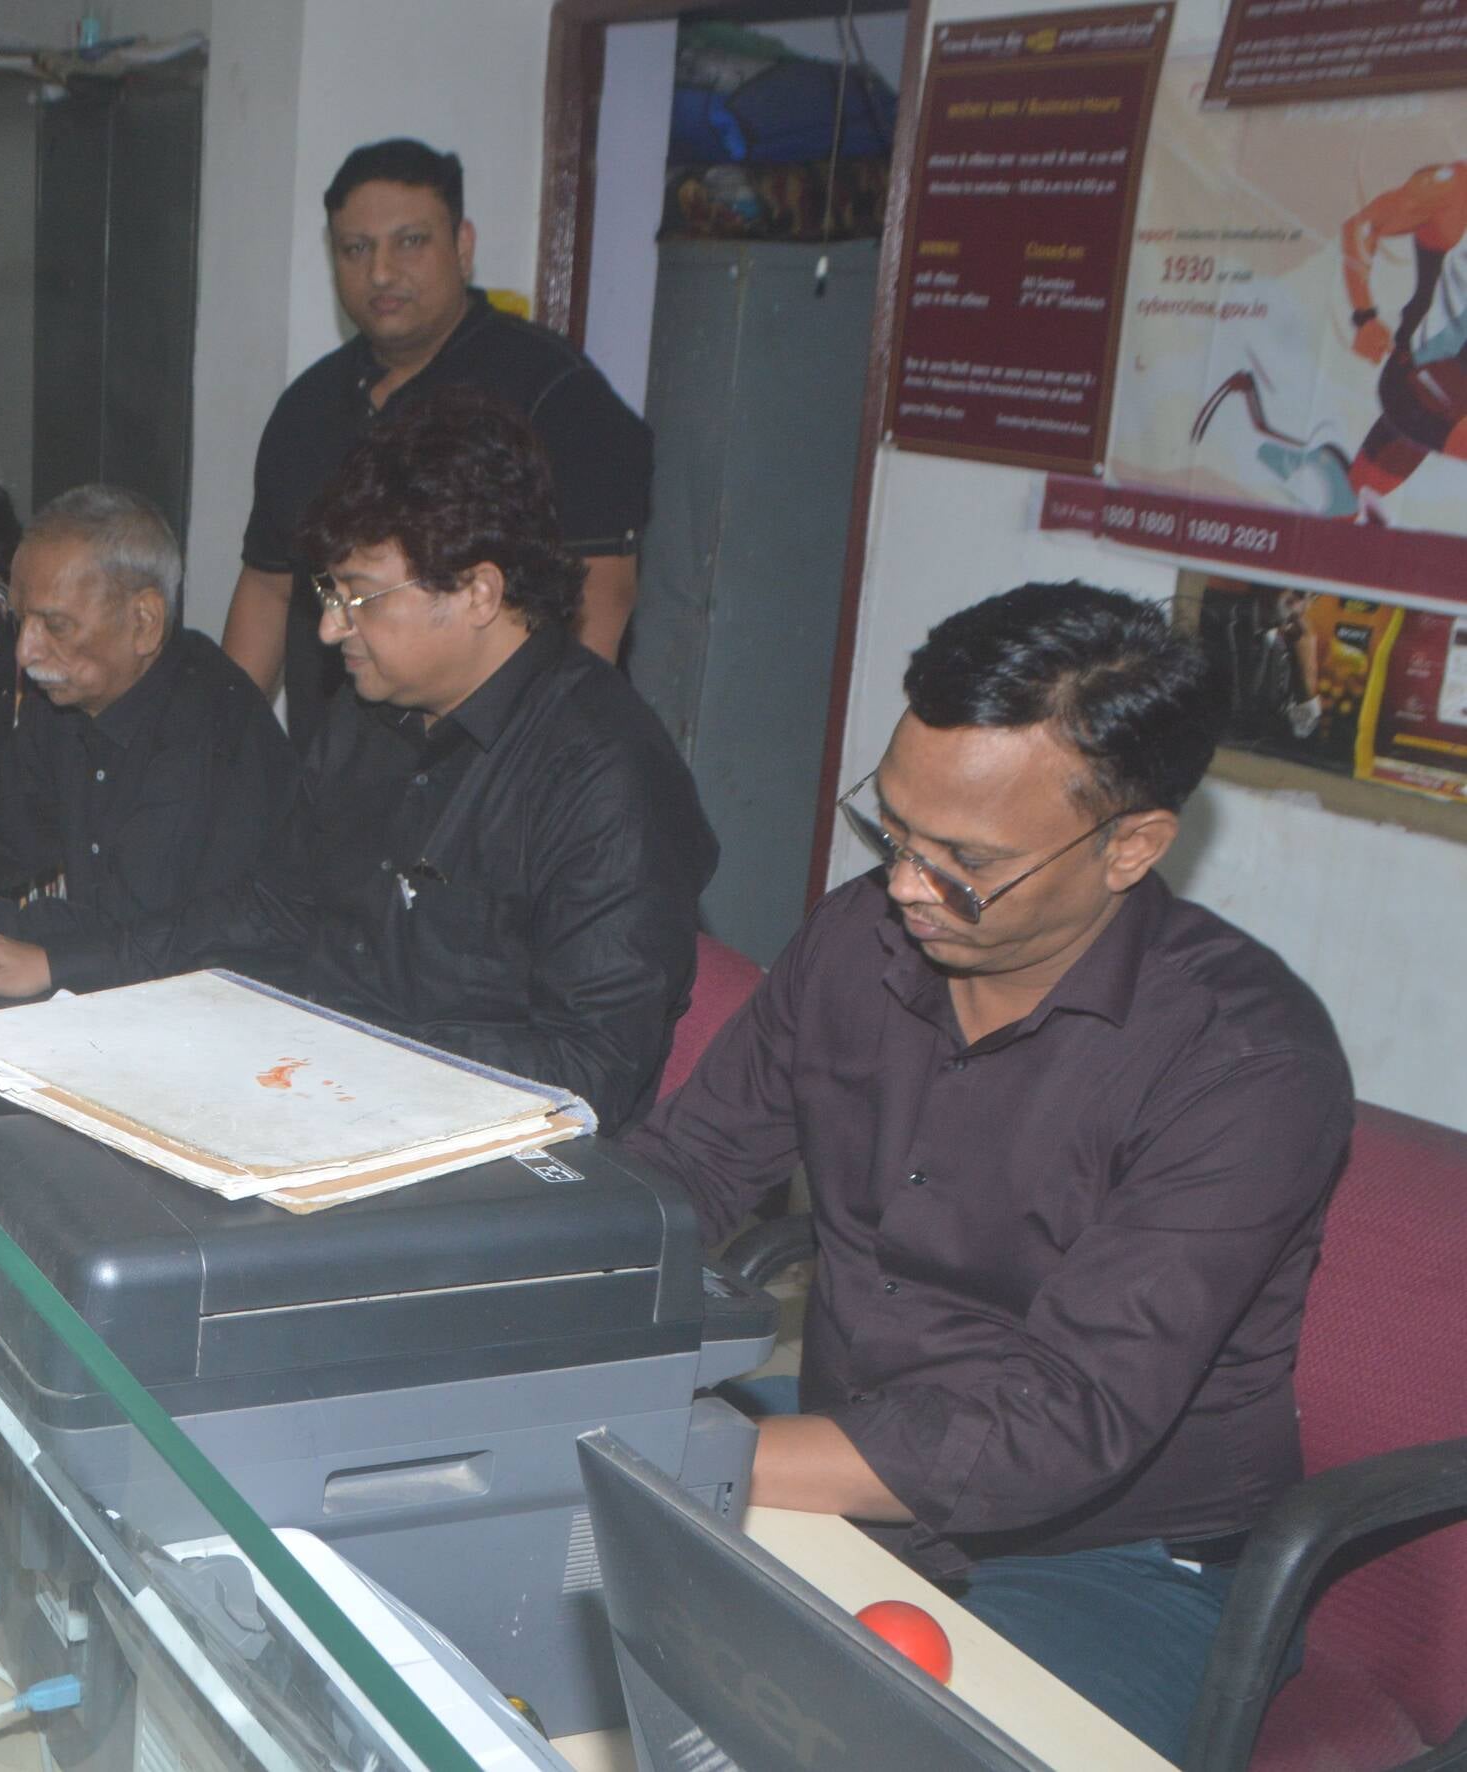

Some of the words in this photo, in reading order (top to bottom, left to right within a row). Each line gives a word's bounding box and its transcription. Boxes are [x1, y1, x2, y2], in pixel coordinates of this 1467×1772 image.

[1161, 255, 1216, 283] 1930
[1136, 295, 1269, 319] cybercrime.gov.in
[1101, 503, 1135, 529] 1800
[1137, 510, 1176, 536] 1800
[1188, 518, 1231, 545] 1800
[1232, 525, 1280, 553] 2021
